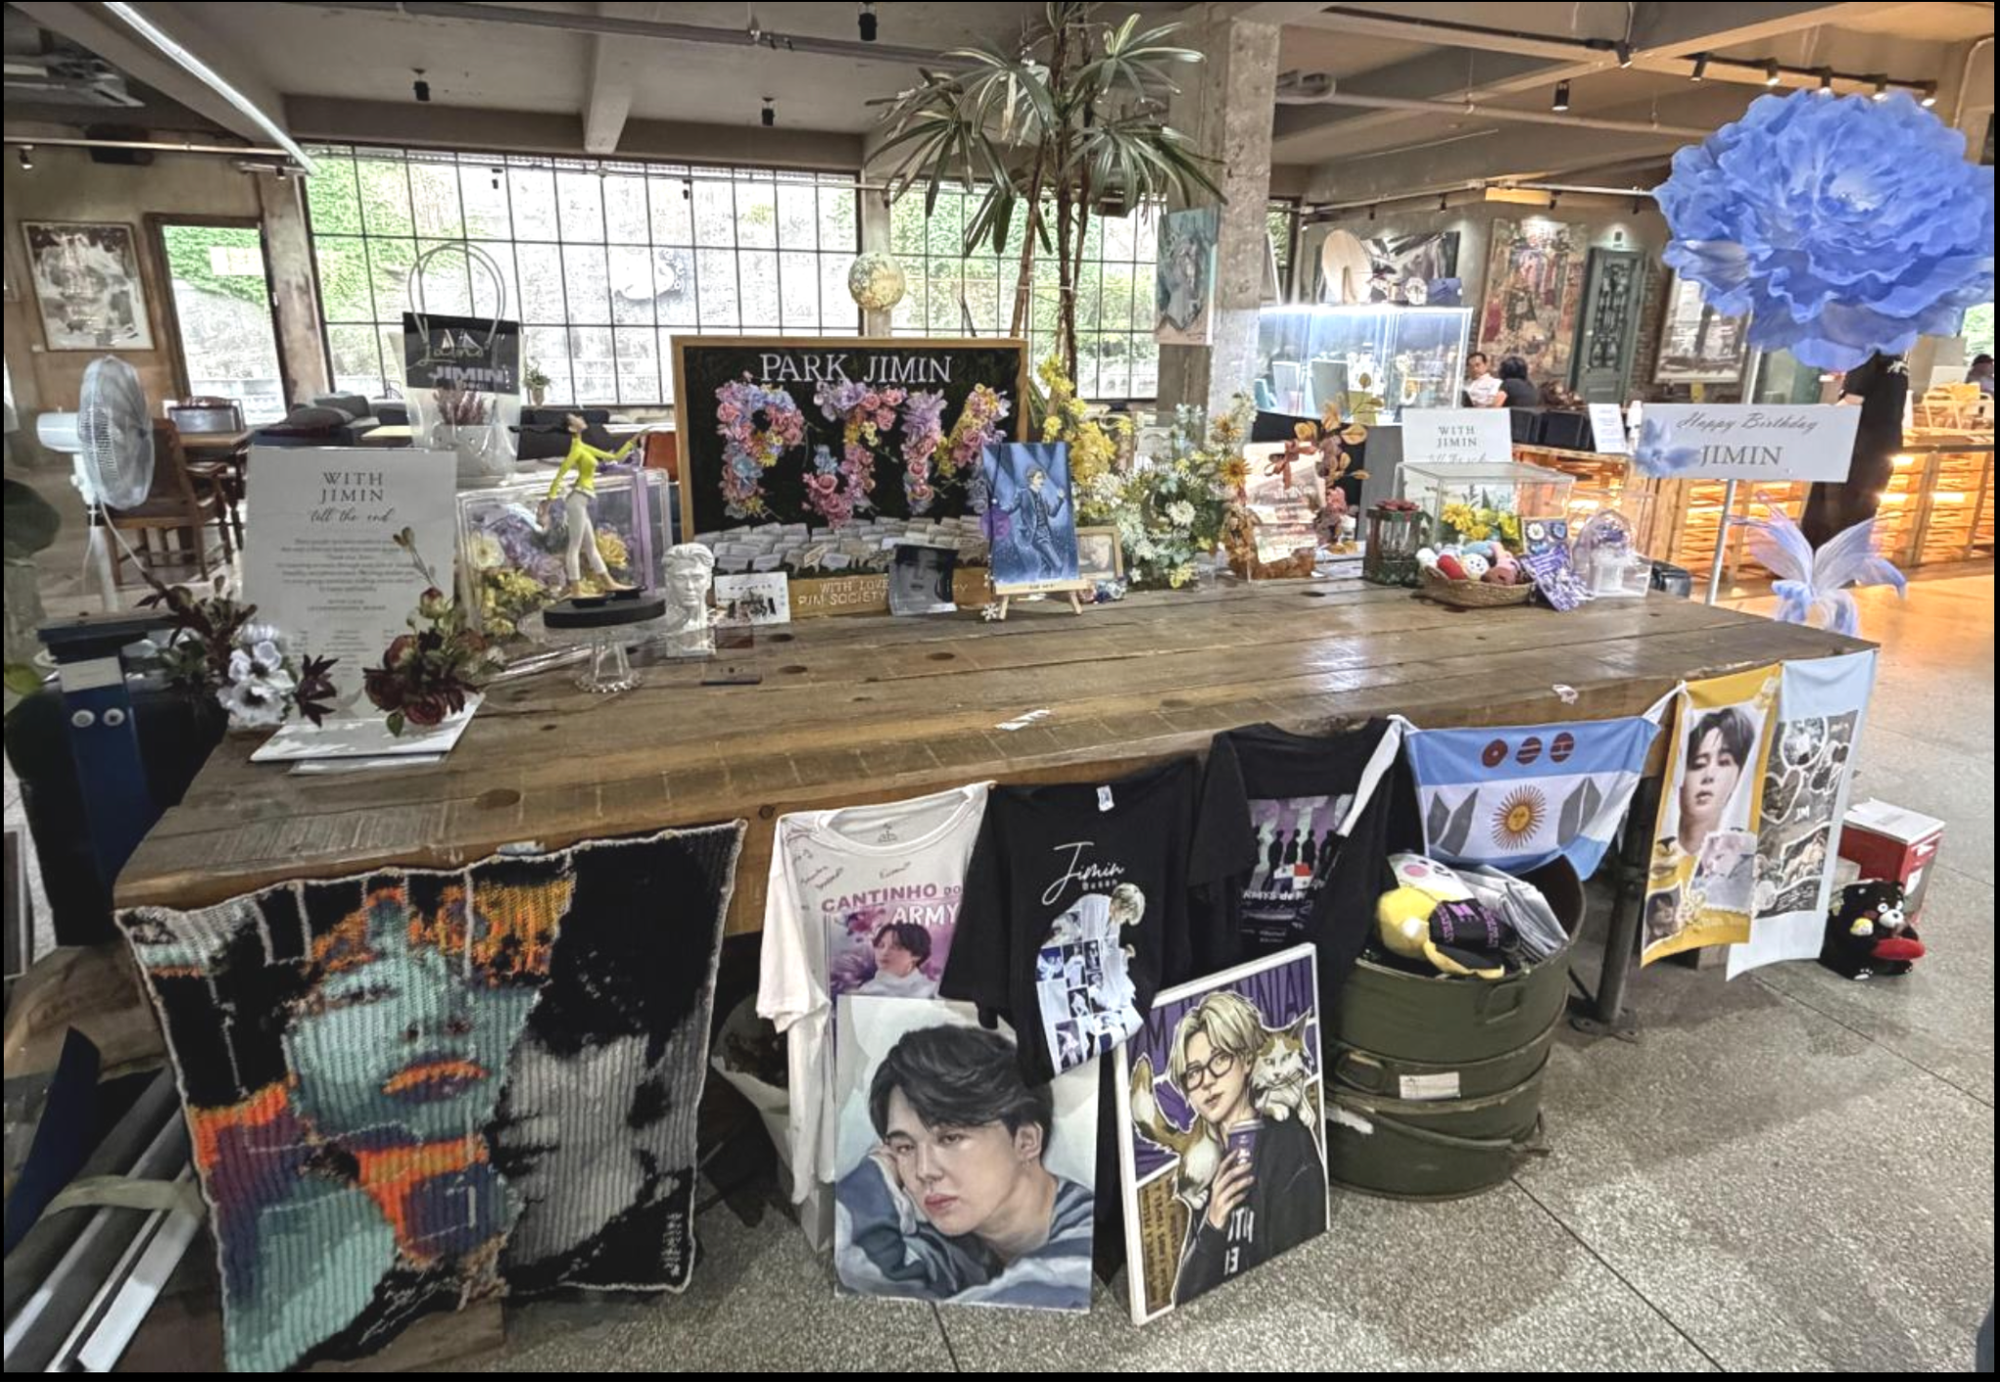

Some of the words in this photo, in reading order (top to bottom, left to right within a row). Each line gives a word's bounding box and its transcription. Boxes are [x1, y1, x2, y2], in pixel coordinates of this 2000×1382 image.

[427, 366, 504, 382] JIMIN
[759, 352, 849, 383] PARK
[862, 355, 953, 384] JIMIN
[1438, 425, 1475, 435] WITH
[1676, 411, 1737, 434] Happy
[1741, 412, 1820, 435] Birthday
[1435, 437, 1477, 449] JIMIN
[1700, 444, 1783, 467] JIMIN
[323, 472, 383, 486] WITH
[320, 489, 384, 505] JIMIN
[367, 507, 395, 522] end
[820, 581, 853, 594] WITH
[859, 579, 889, 592] LOVE
[830, 590, 886, 606] SOCIETY
[1041, 841, 1125, 906] Jimin
[821, 883, 937, 912] CANTINHO
[892, 902, 959, 927] ARMY
